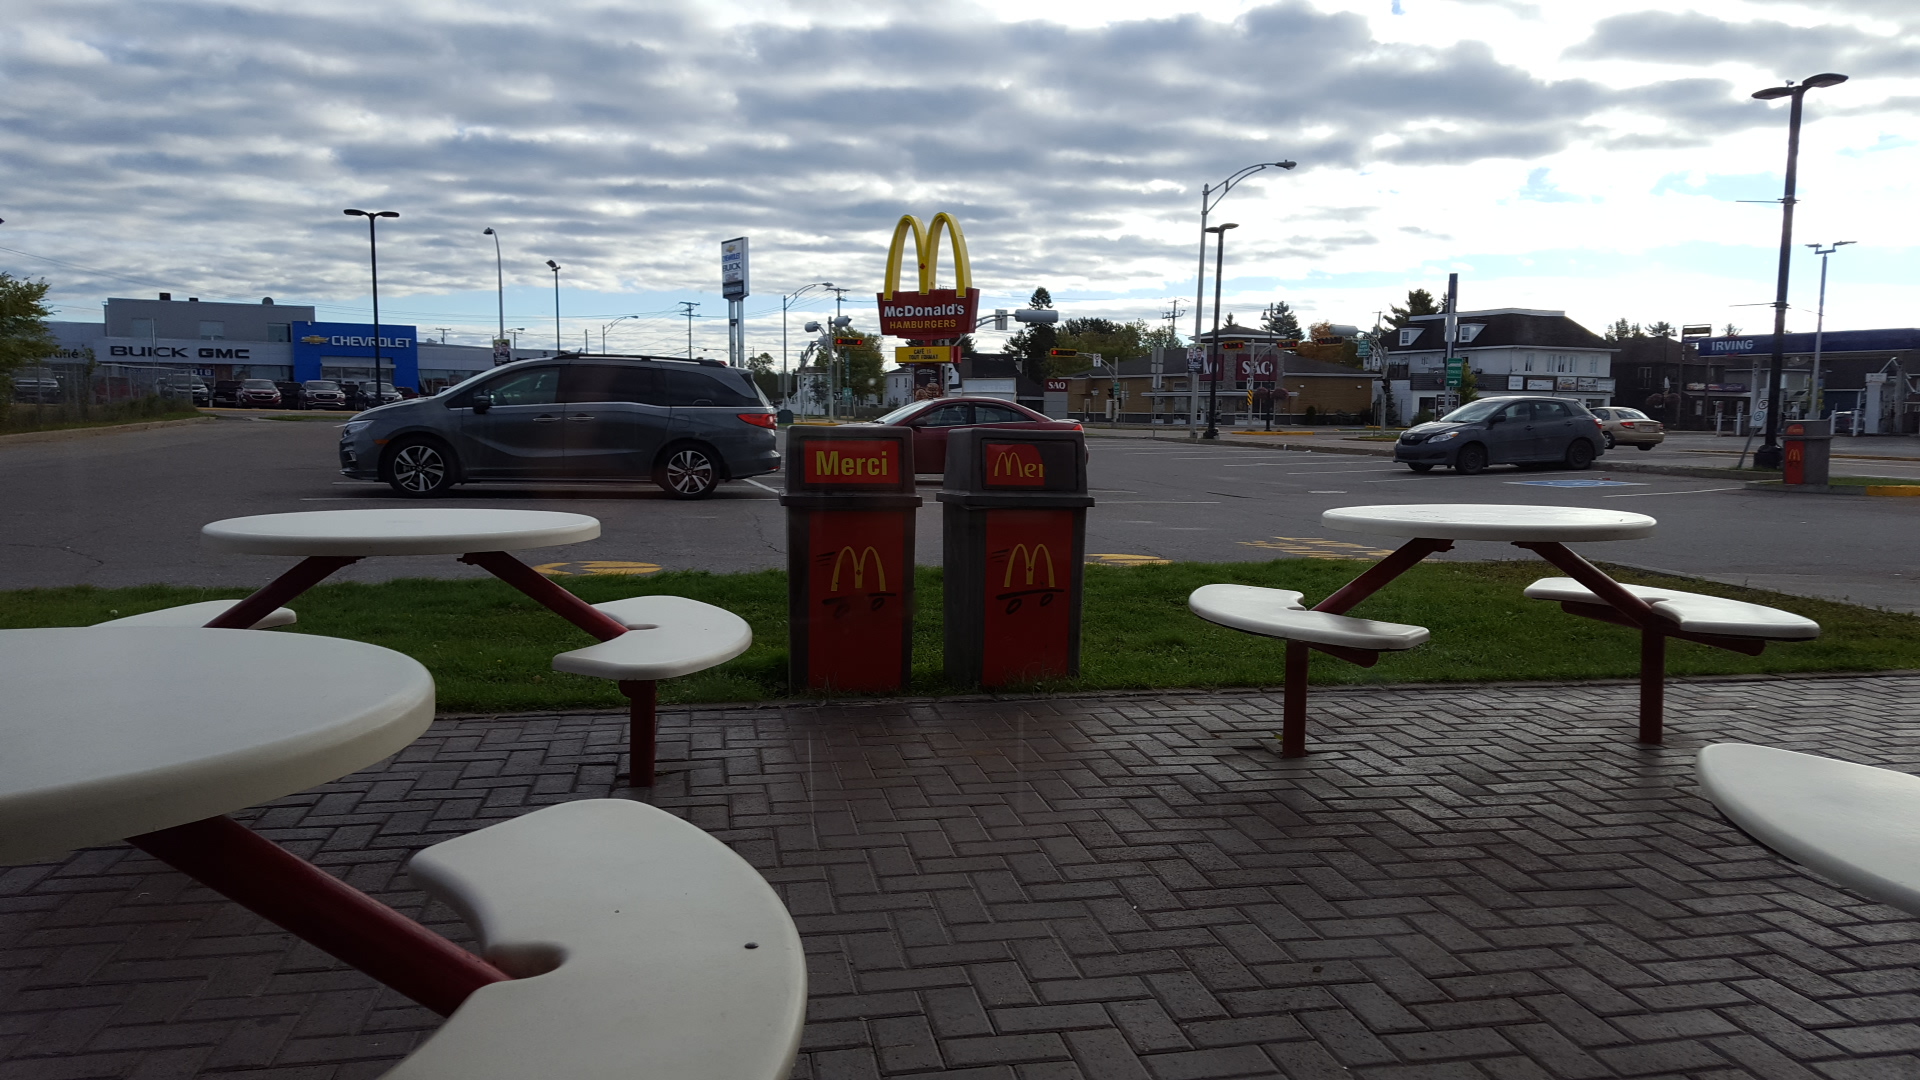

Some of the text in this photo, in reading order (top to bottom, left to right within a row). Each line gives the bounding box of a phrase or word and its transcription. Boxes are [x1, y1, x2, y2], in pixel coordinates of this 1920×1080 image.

[722, 261, 741, 272] BUICK
[883, 303, 965, 318] McDonald's
[889, 319, 957, 329] HAMBURGERS
[331, 335, 412, 348] CHEVROLET
[1711, 339, 1754, 351] IRVING
[110, 345, 250, 359] BUICK GMC
[1241, 360, 1274, 376] SAQ
[1048, 381, 1066, 390] SAQ
[815, 450, 888, 476] Merci
